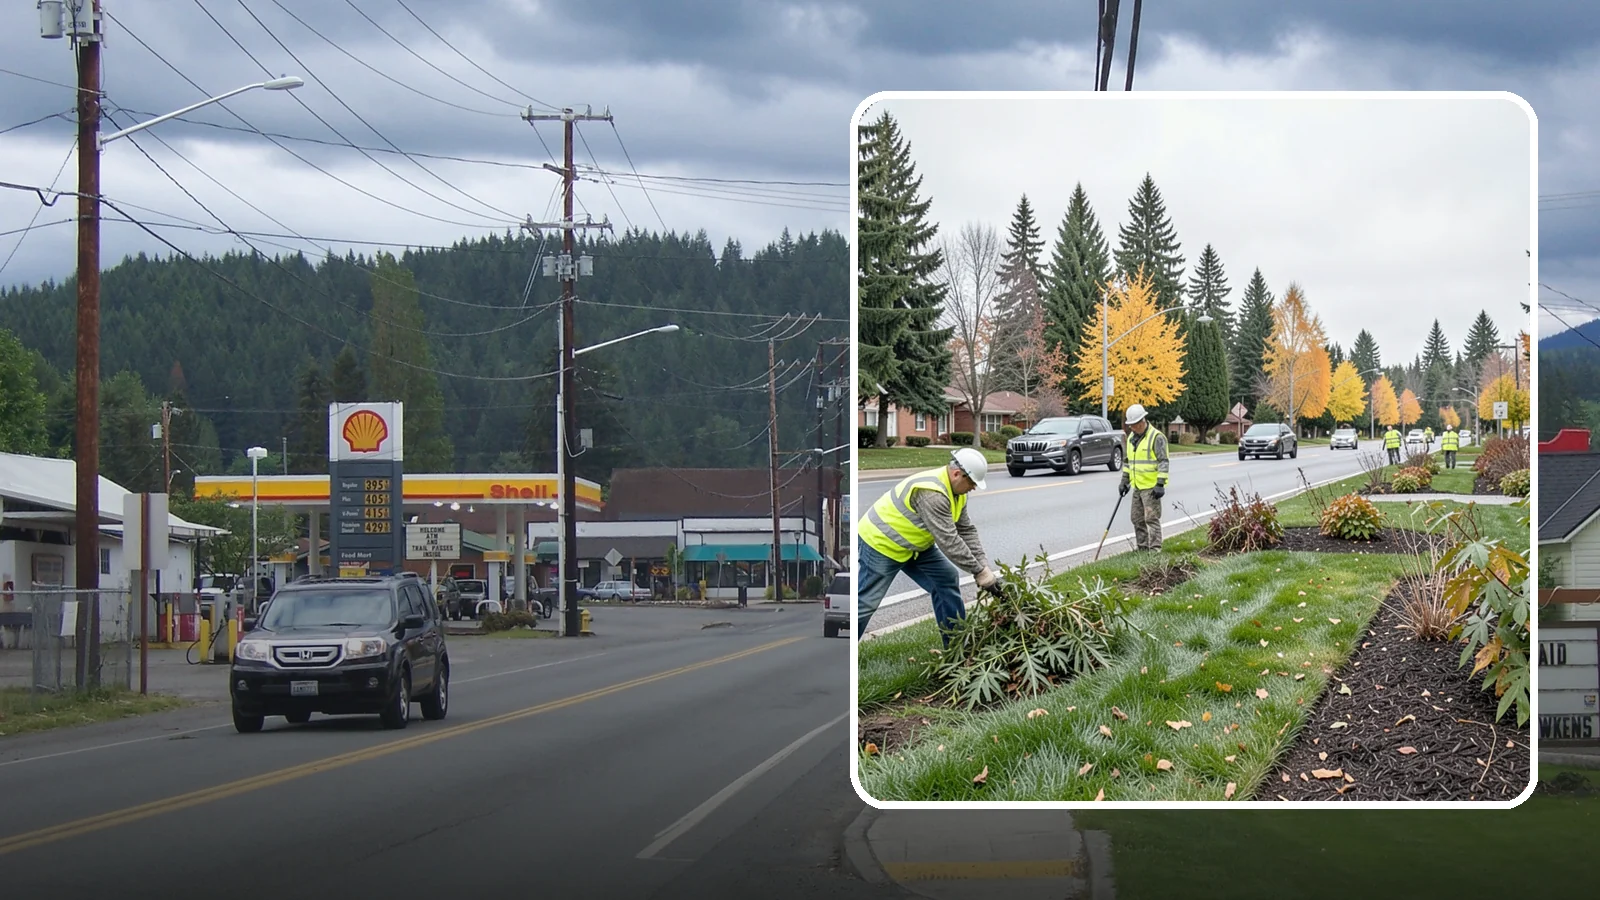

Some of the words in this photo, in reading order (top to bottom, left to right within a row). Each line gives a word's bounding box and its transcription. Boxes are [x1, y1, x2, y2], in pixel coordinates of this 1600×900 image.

[366, 480, 383, 490] 395
[490, 484, 547, 498] Shell
[366, 494, 383, 504] 405
[366, 509, 383, 518] 415
[366, 522, 383, 532] 429
